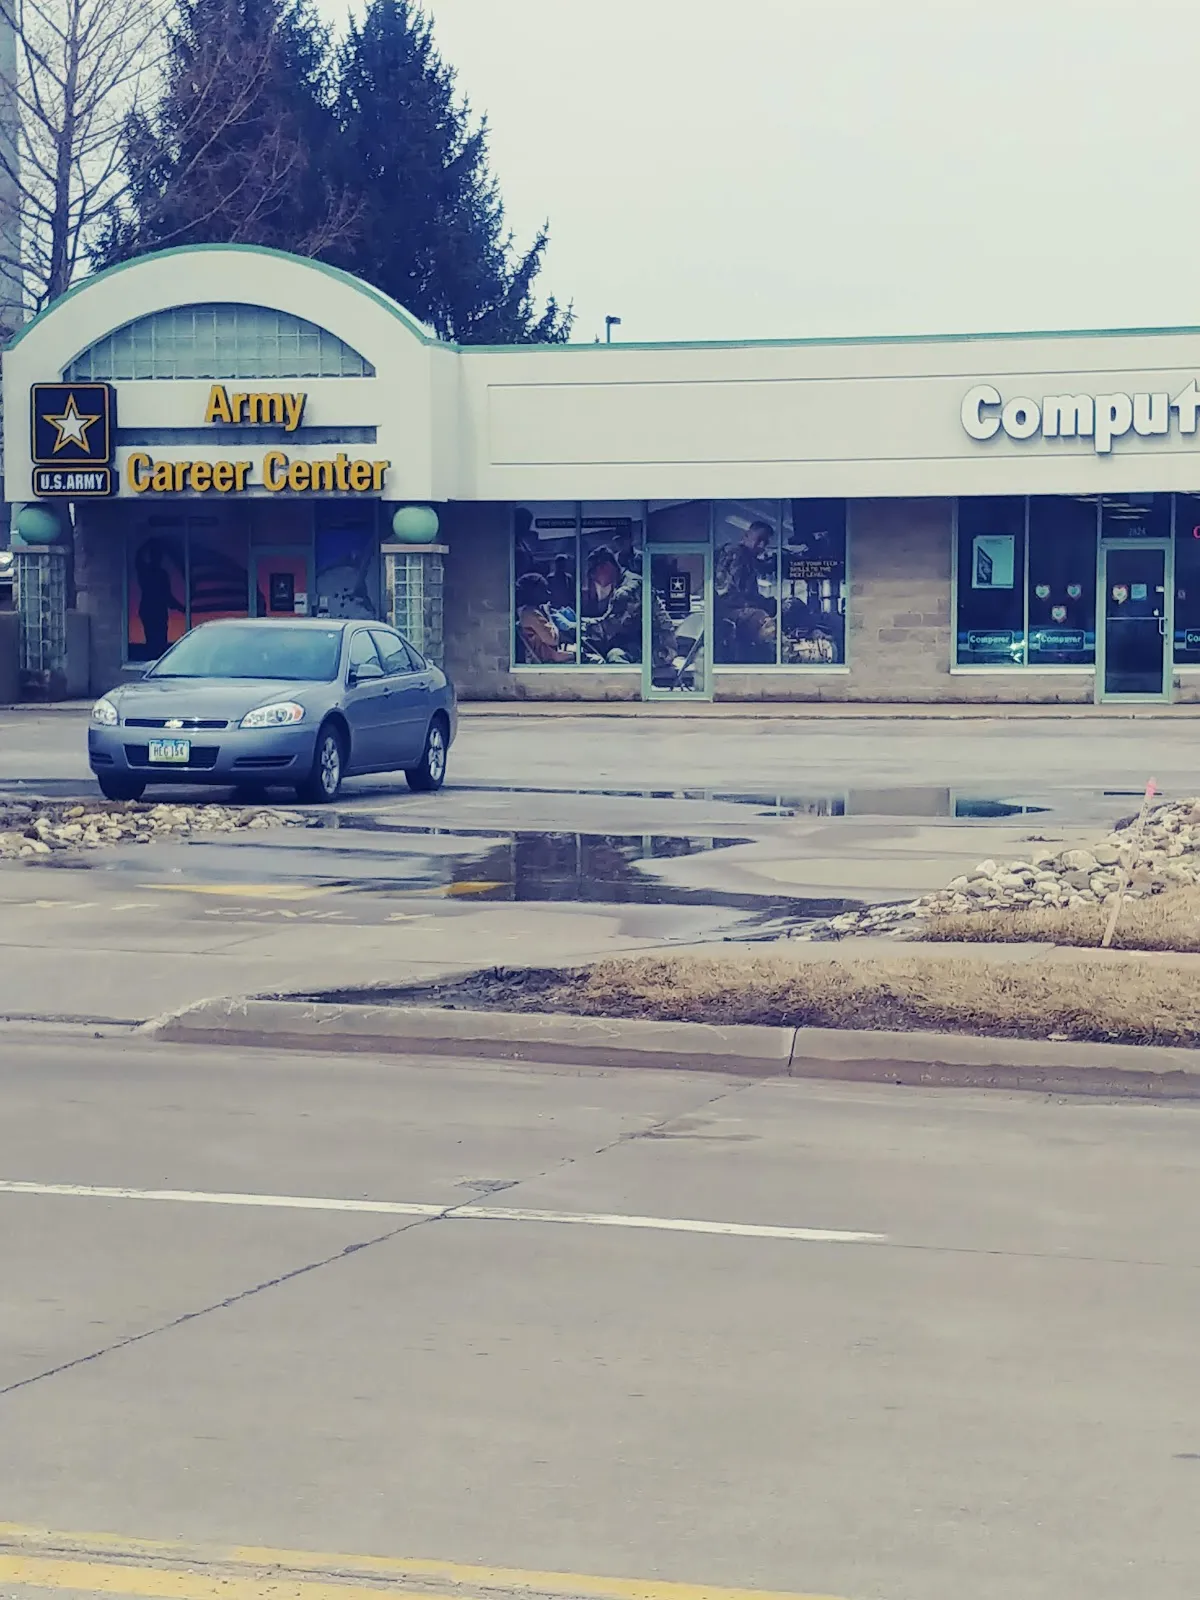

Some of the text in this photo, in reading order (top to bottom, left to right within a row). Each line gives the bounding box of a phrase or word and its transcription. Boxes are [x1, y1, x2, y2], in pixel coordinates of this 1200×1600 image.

[204, 384, 307, 431] Army
[961, 378, 1200, 453] Comput
[127, 452, 390, 493] Career Center
